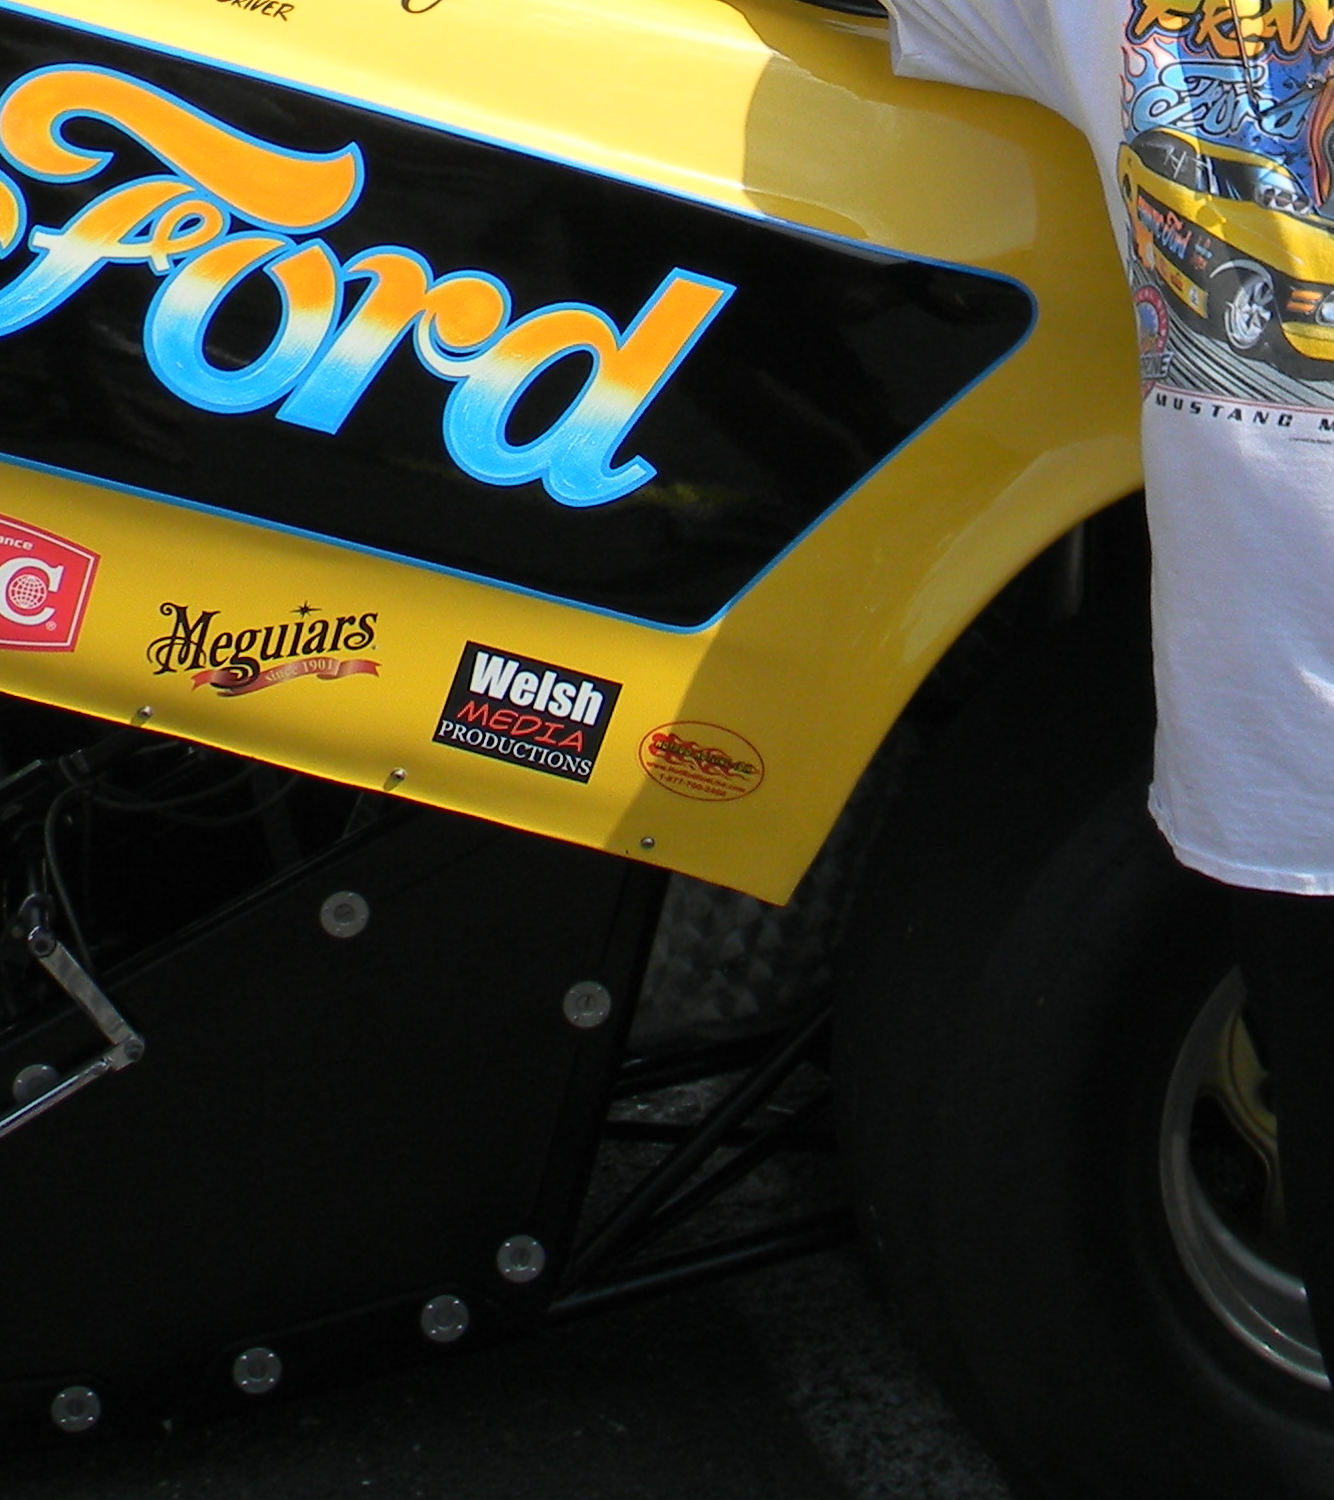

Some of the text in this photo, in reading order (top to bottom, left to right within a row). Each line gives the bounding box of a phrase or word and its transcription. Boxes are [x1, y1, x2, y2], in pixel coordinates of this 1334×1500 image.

[1154, 392, 1294, 428] MUSTANG
[301, 657, 335, 674] 1901
[468, 650, 604, 726] Welsh
[438, 719, 593, 778] PRODUCTIONS
[457, 700, 585, 753] MEDIA
